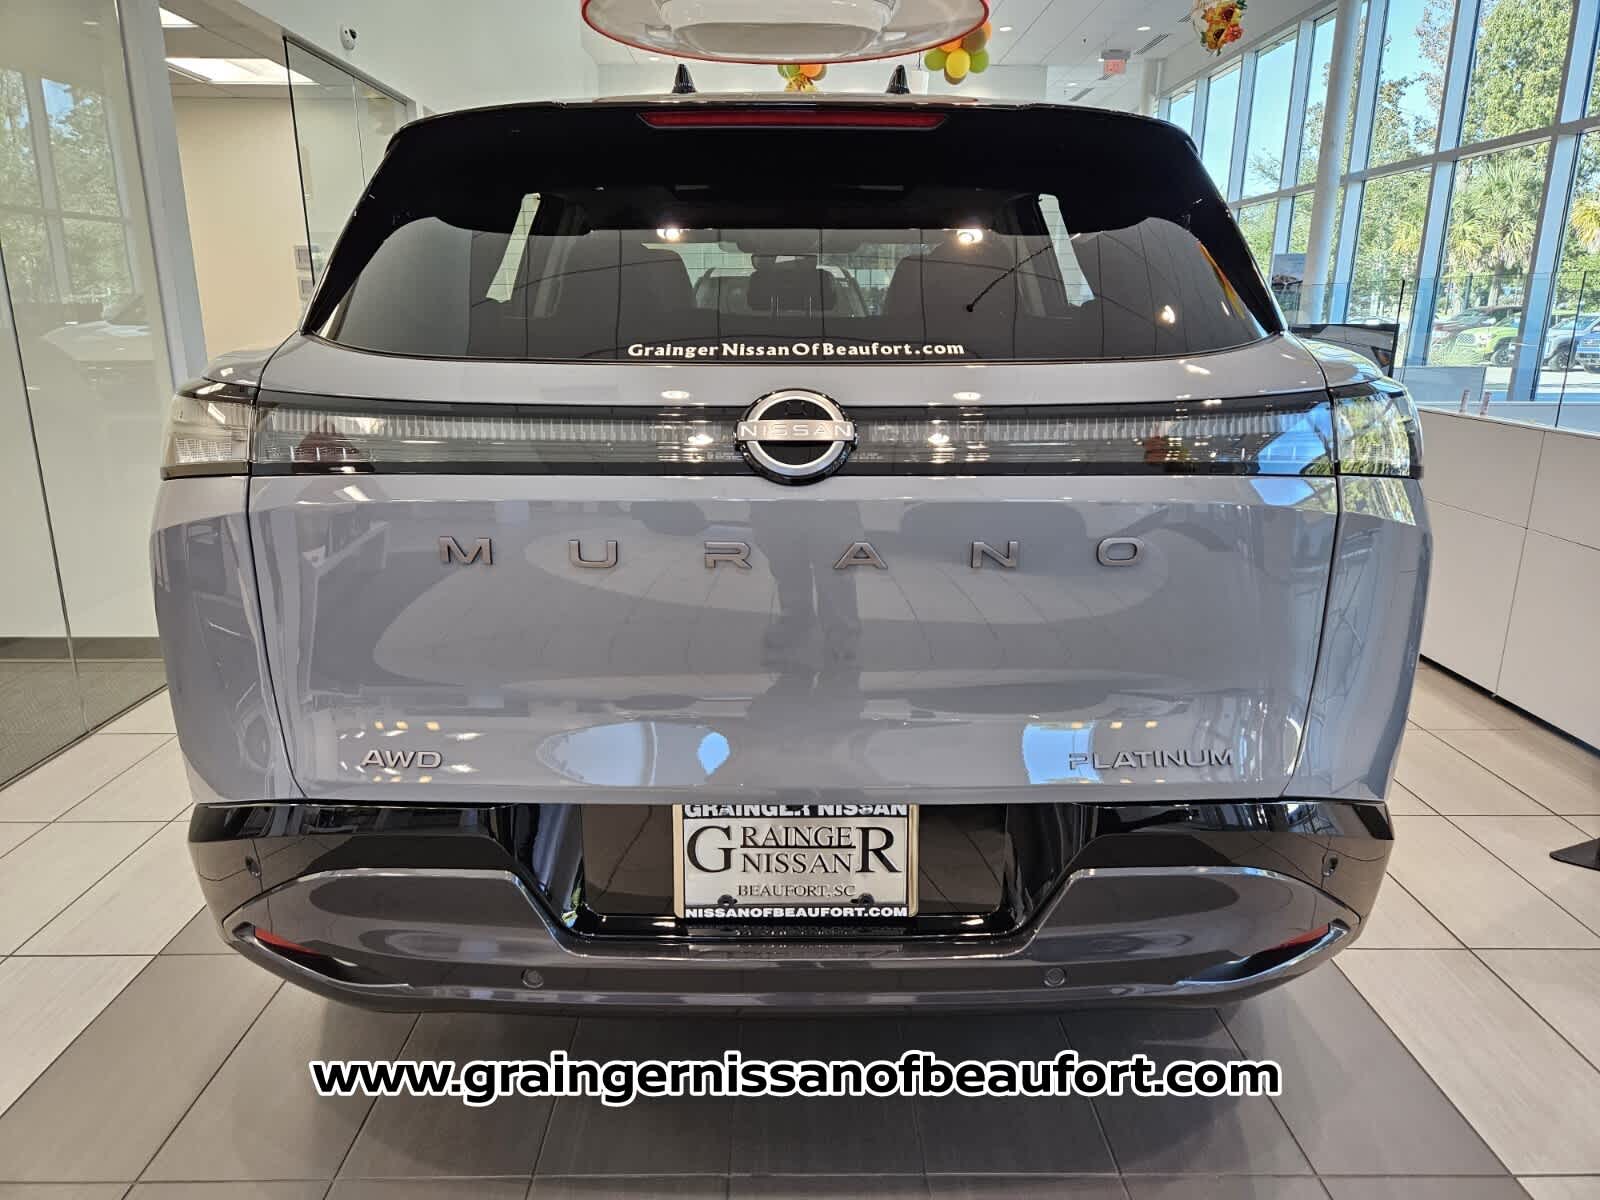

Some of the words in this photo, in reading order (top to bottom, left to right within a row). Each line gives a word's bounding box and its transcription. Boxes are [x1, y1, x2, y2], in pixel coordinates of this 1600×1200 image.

[627, 342, 965, 359] GraingerNissanOfBeaufort.com
[740, 424, 851, 437] NISSAN
[439, 535, 1145, 569] MURANO
[362, 749, 443, 769] AWD
[1068, 748, 1234, 770] PLATINUM
[818, 804, 907, 816] NISSAN
[741, 853, 855, 873] NISSAN
[834, 885, 856, 897] SC
[685, 907, 908, 918] NISSANOFBEAUFORT.COM
